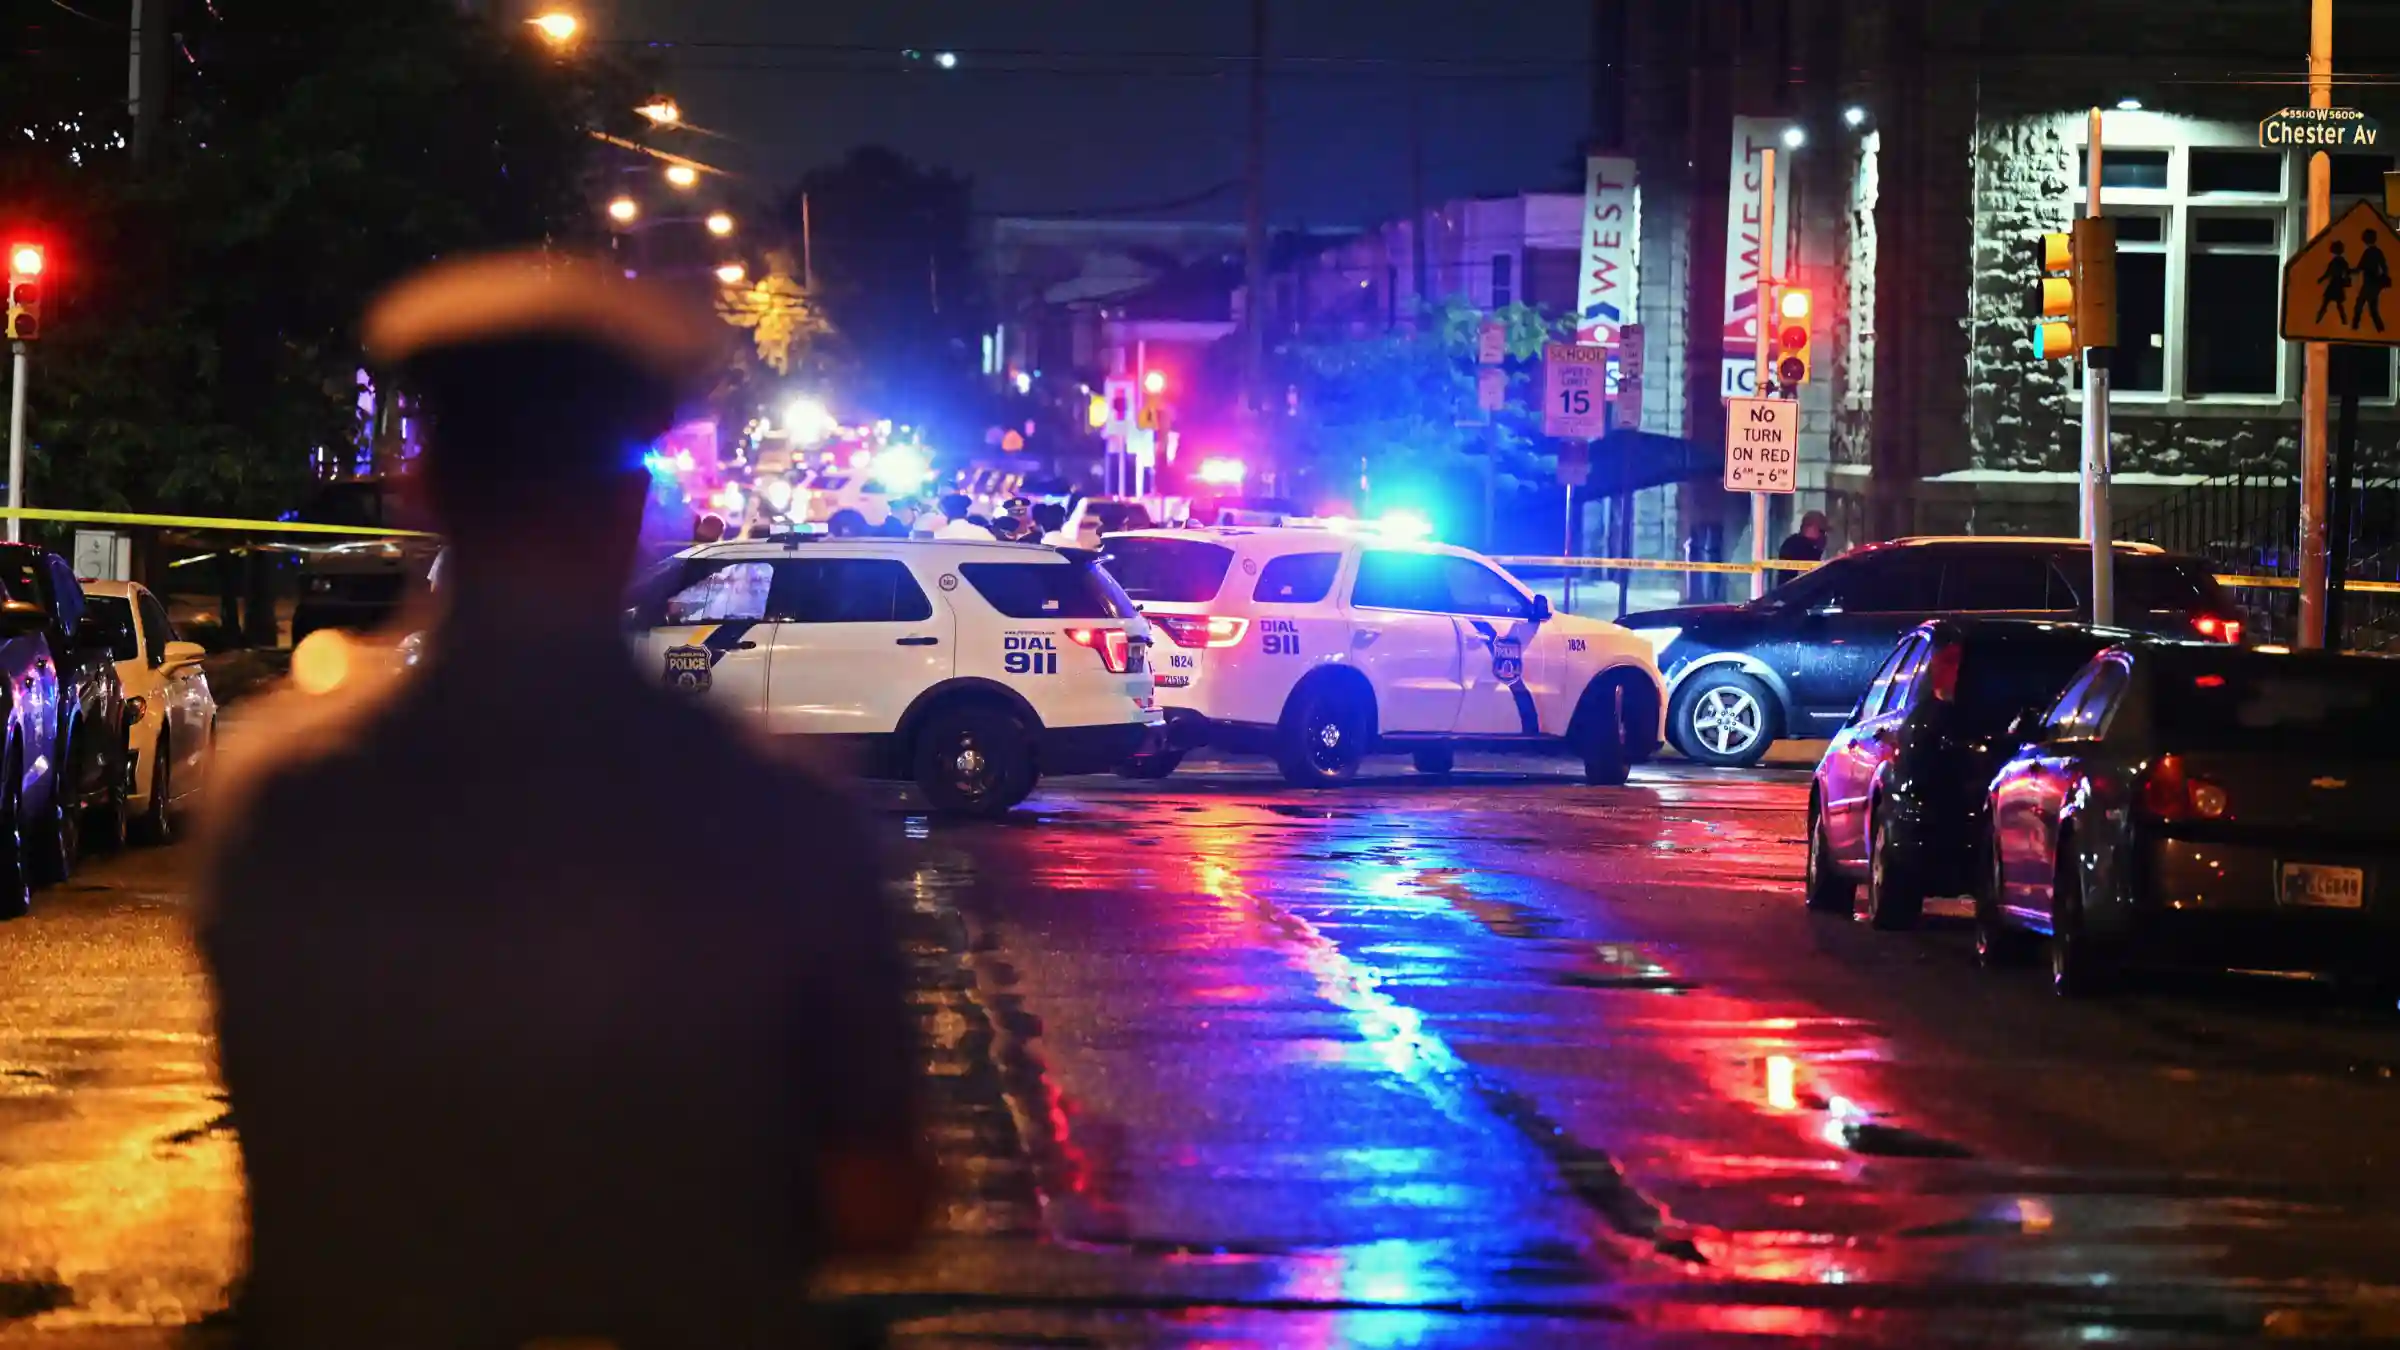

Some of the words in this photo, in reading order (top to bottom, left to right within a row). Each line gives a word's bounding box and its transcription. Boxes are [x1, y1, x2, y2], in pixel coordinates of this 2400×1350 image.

[2267, 121, 2346, 144] Chester
[2354, 124, 2377, 145] Av
[1590, 171, 1625, 295] WEST
[1726, 367, 1779, 392] IC
[1560, 390, 1590, 415] 15
[1750, 408, 1775, 422] NO
[1743, 428, 1782, 442] TURN
[1733, 447, 1753, 461] ON
[1761, 448, 1790, 462] RED
[1261, 620, 1299, 633] DIAL
[1004, 637, 1057, 650] DIAL
[1262, 634, 1300, 655] 911
[1567, 638, 1586, 651] 1824
[670, 657, 706, 670] POLICE
[1004, 652, 1057, 674] 911
[1169, 655, 1194, 668] 1824
